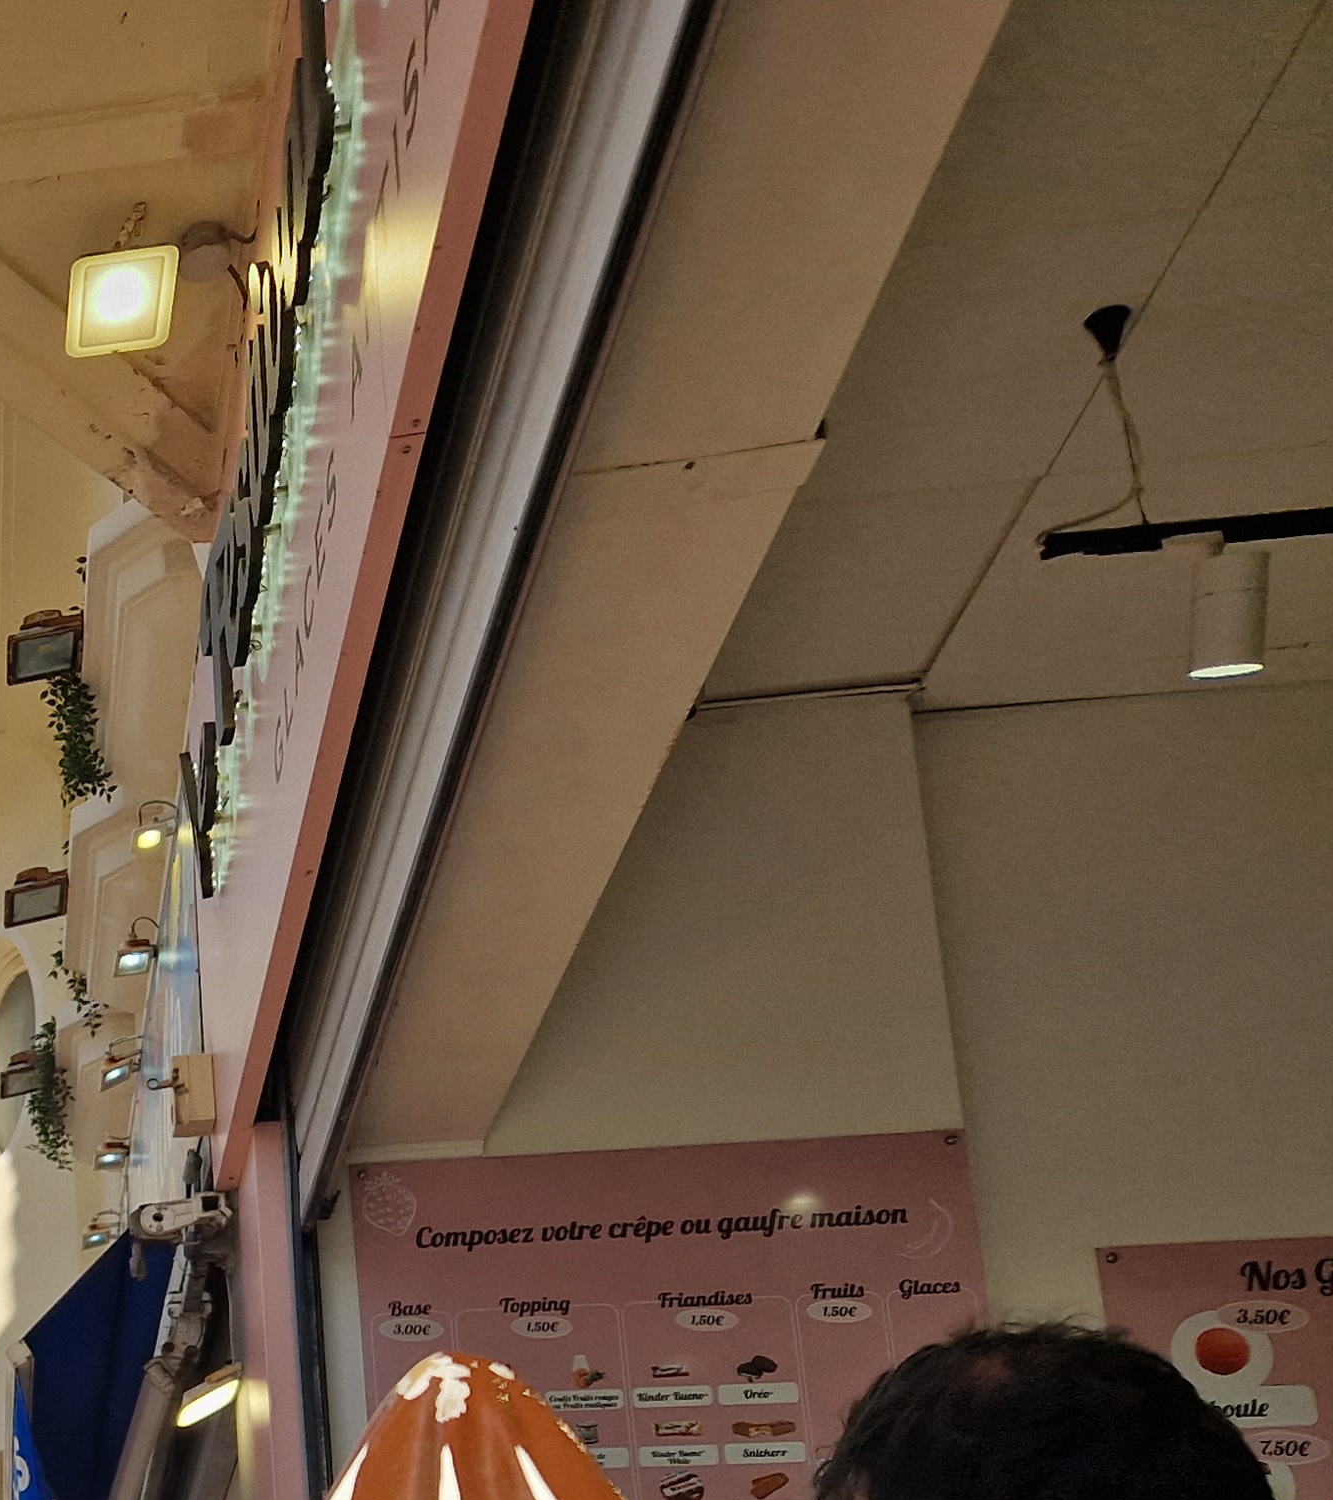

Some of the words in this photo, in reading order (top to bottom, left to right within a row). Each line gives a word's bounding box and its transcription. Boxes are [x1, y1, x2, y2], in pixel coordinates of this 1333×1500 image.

[274, 449, 336, 784] GLACES
[415, 1225, 534, 1252] Composez
[541, 1221, 602, 1242] votre
[608, 1215, 674, 1244] crêpe
[680, 1219, 711, 1235] ou
[717, 1208, 802, 1240] gaufre
[810, 1205, 908, 1229] maison
[1240, 1260, 1307, 1292] Nos
[810, 1283, 865, 1300] Fruits
[898, 1278, 961, 1299] Glaces
[388, 1301, 432, 1317] Base
[499, 1297, 571, 1317] Topping
[657, 1292, 753, 1309] Friandises
[823, 1305, 858, 1317] 1.50€
[1236, 1308, 1291, 1325] 3.50€
[526, 1321, 559, 1333] 1.50€
[690, 1314, 725, 1327] 1.50€
[393, 1324, 431, 1336] 3.00€
[637, 1393, 671, 1402] Kinder
[673, 1392, 709, 1400] Bueno
[742, 1448, 788, 1458] Snickers
[1259, 1440, 1312, 1457] 7.50€
